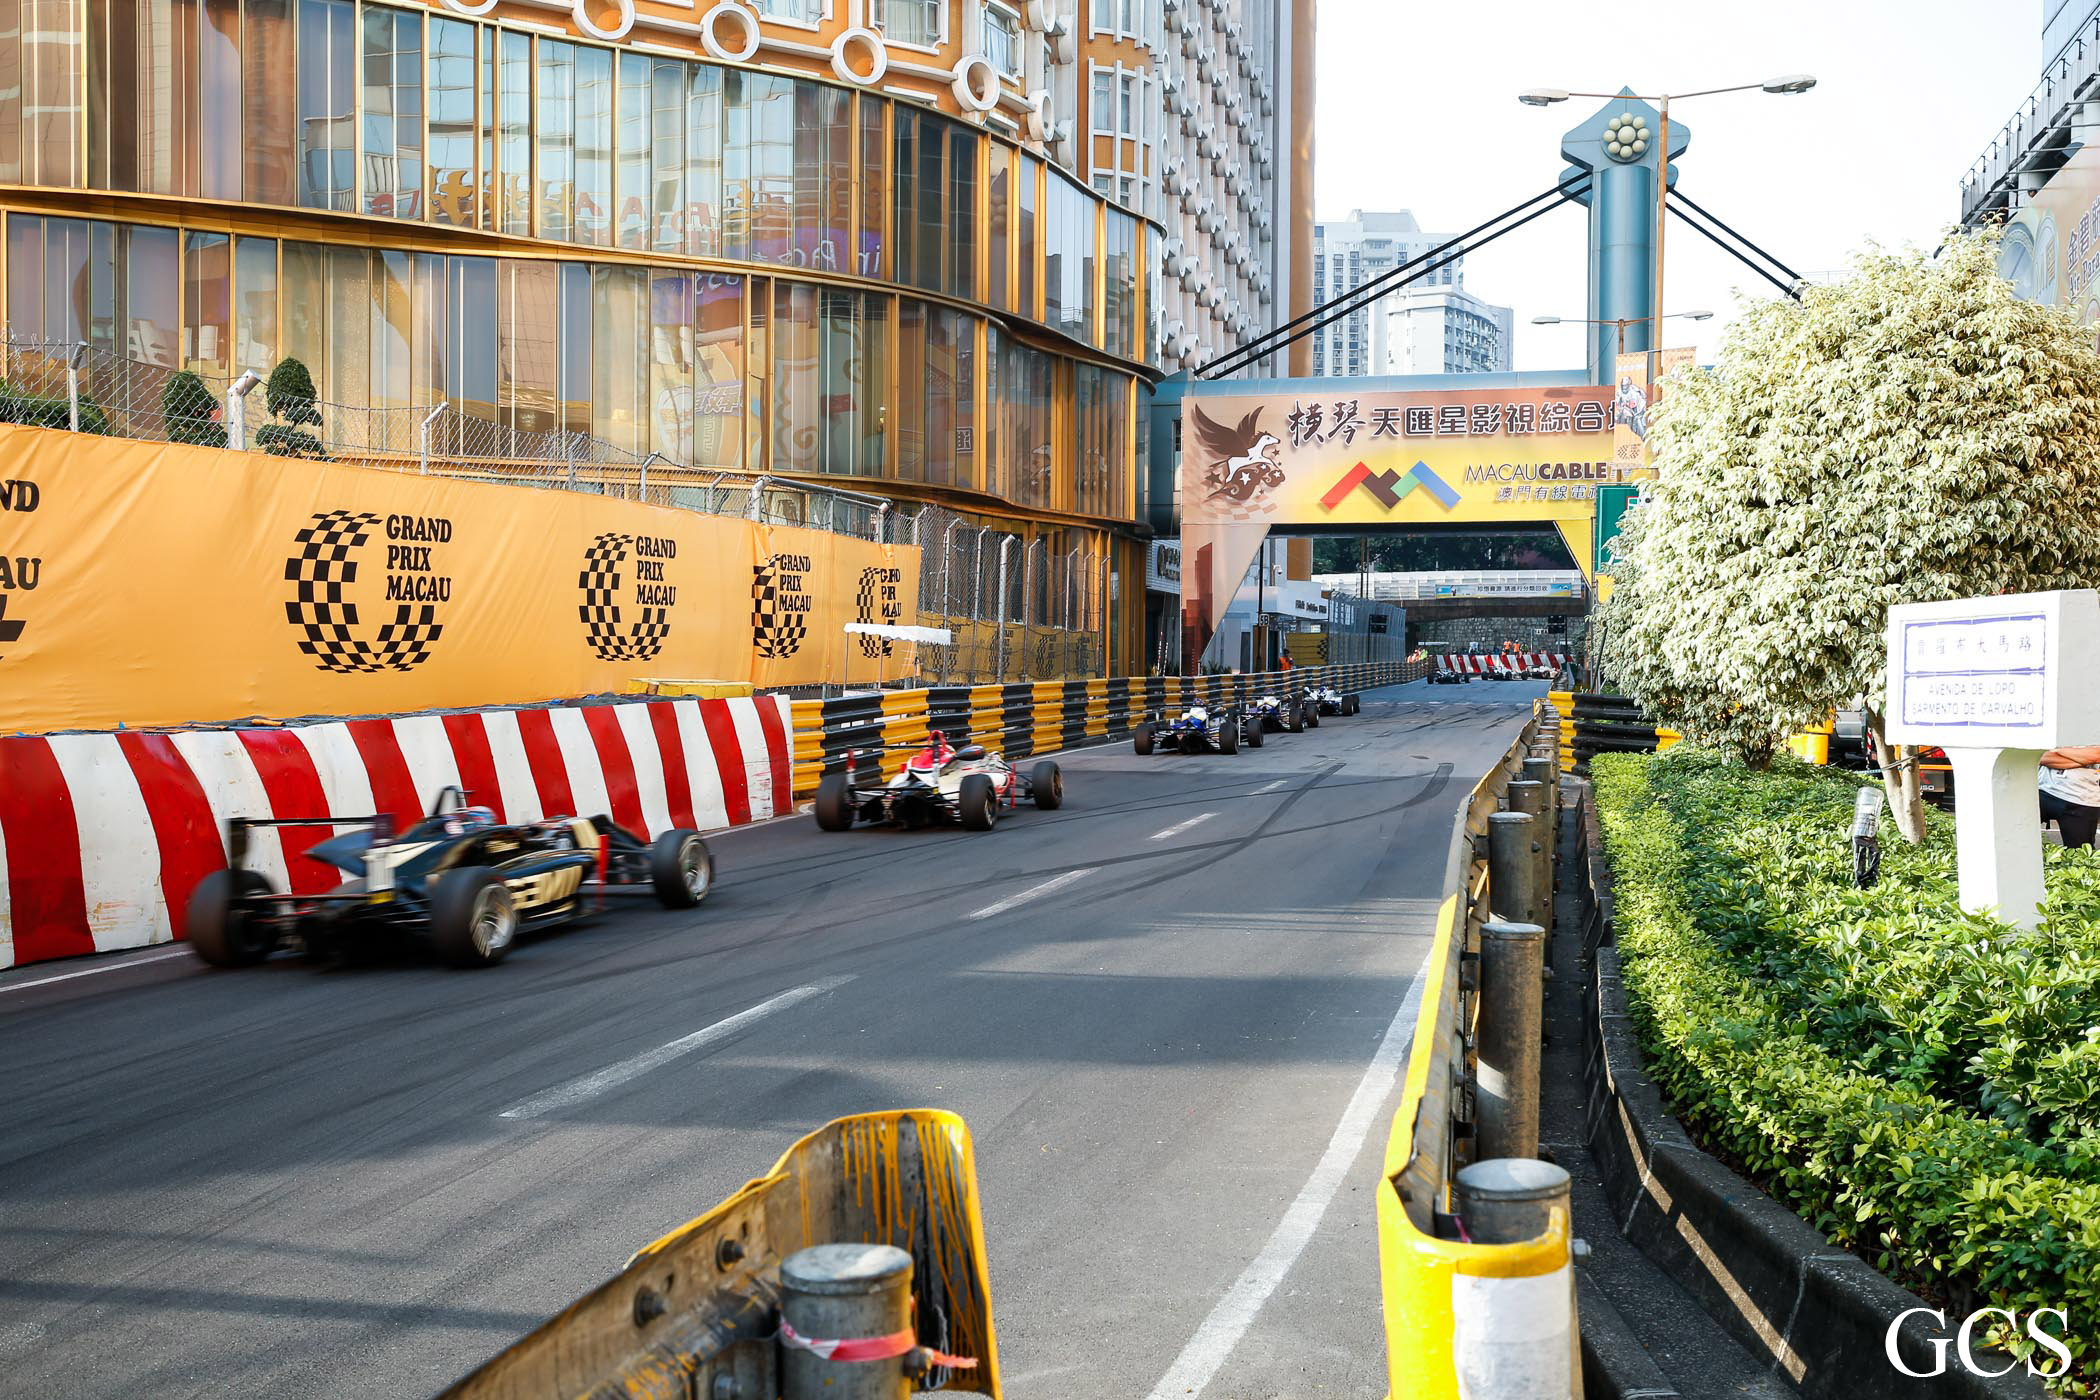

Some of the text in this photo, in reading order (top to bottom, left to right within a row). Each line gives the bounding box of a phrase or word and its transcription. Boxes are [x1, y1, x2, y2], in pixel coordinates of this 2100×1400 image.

[386, 514, 452, 543] GRAND
[386, 545, 432, 571] PRIX
[636, 535, 676, 559] GRAND
[636, 559, 664, 581] PRIX
[780, 554, 811, 572] GRAND
[385, 575, 452, 602] MACAU
[779, 574, 802, 592] PRIX
[636, 583, 676, 606] MACAU
[778, 594, 812, 612] MACAU
[1928, 682, 2016, 696] AVENIDA DE LOPO
[1912, 702, 2034, 715] SARMENTO DE CARVALHO
